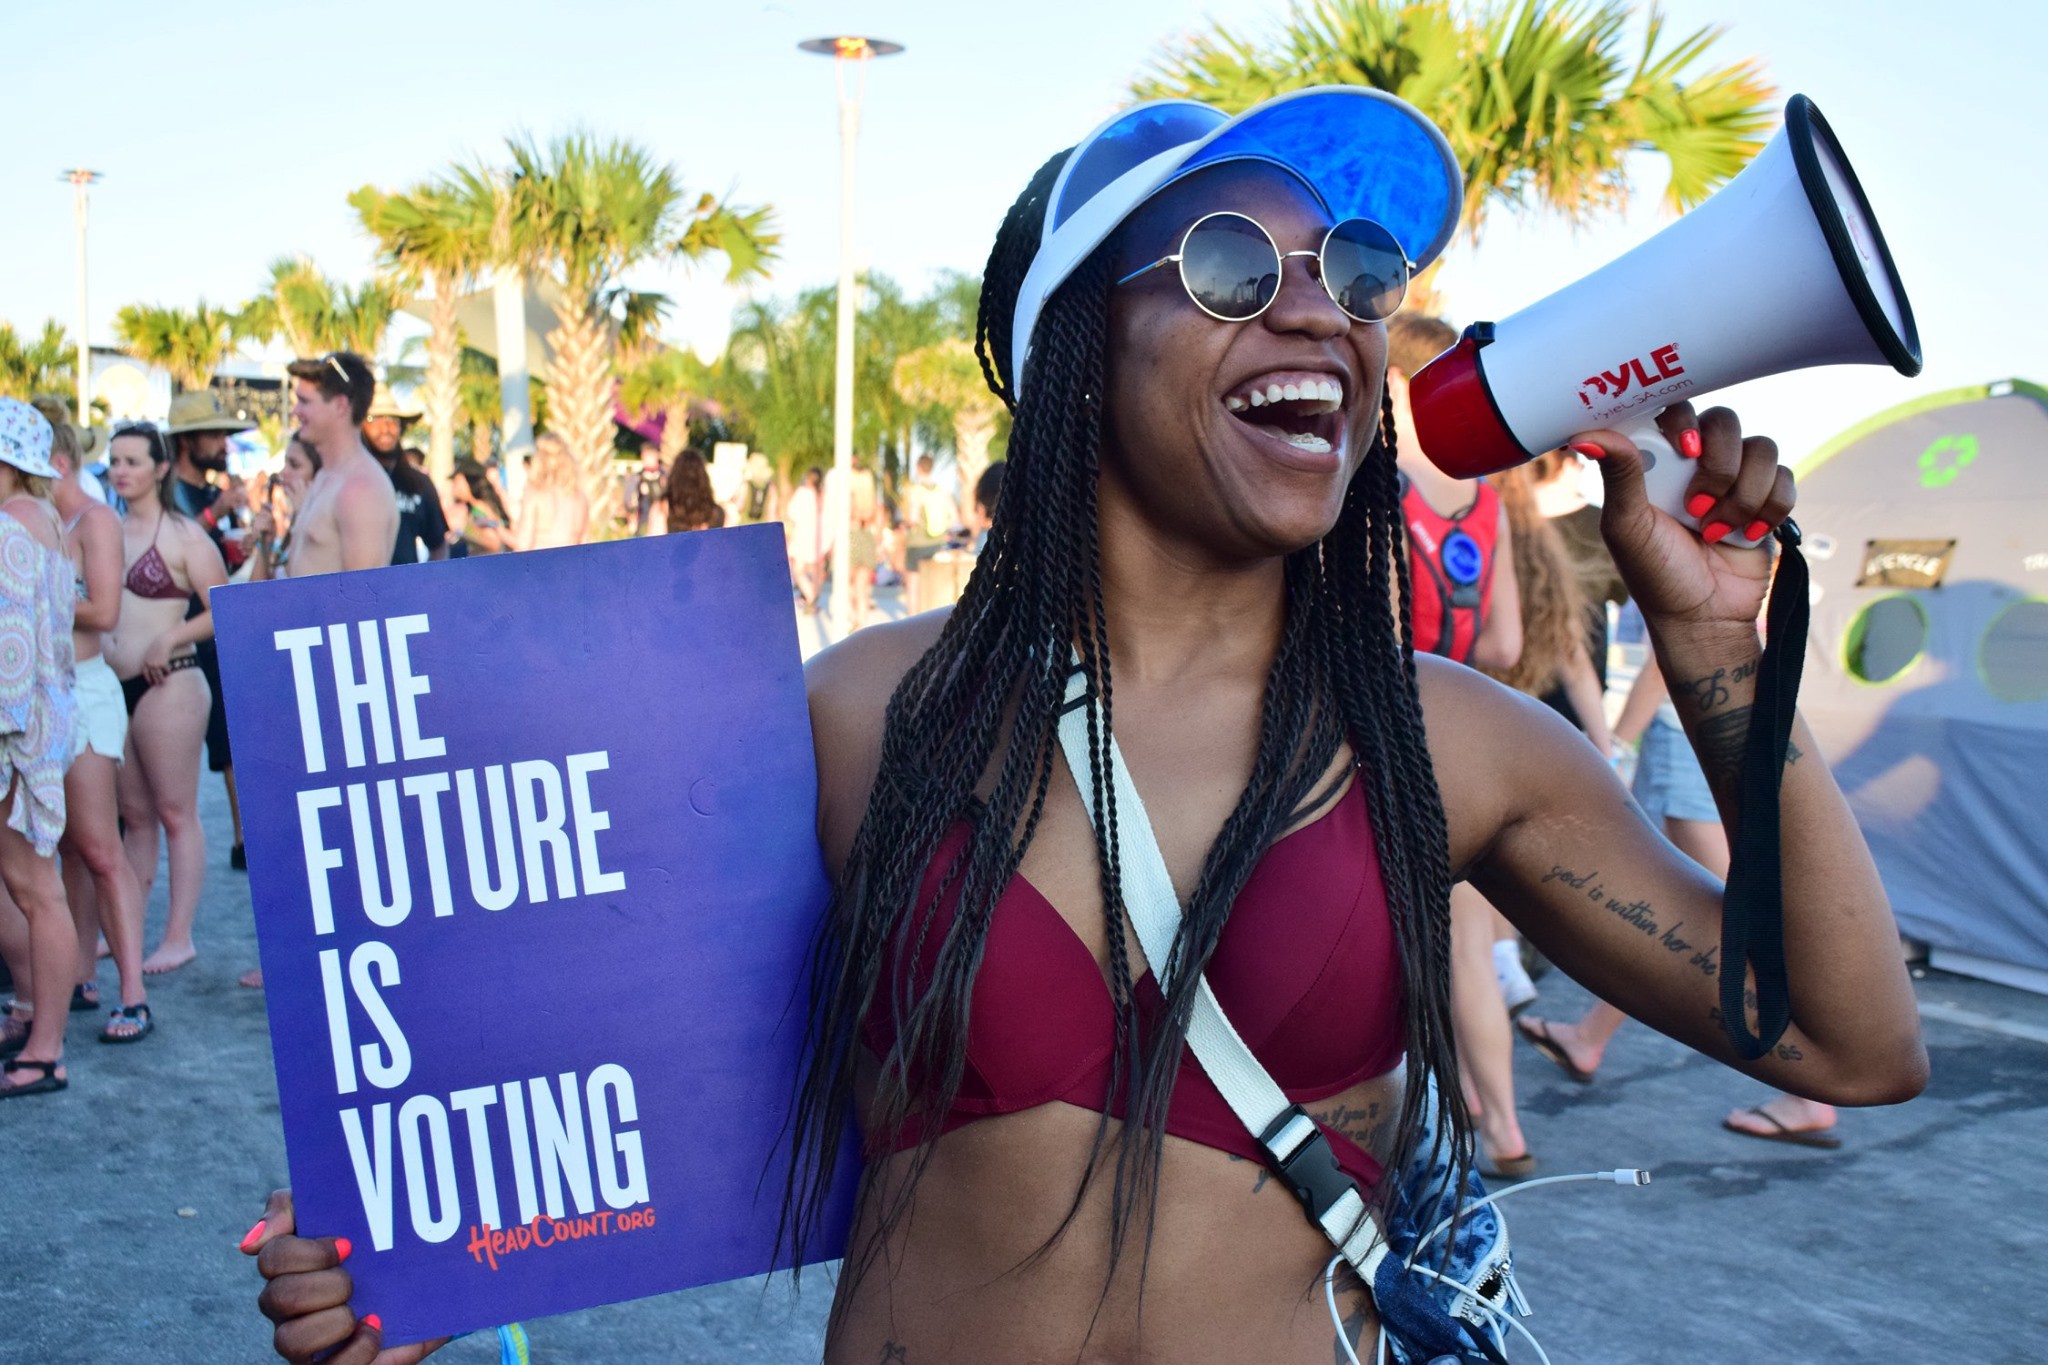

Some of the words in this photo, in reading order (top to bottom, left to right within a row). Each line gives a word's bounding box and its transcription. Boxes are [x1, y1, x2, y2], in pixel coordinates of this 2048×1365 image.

[274, 614, 447, 774] THE
[297, 751, 626, 935] FUTURE
[1541, 865, 1598, 889] god
[1588, 884, 1604, 901] is
[1605, 900, 1659, 936] within
[1659, 921, 1692, 951] her
[1689, 945, 1718, 975] she
[320, 941, 412, 1095] IS
[340, 1064, 650, 1252] VOTING
